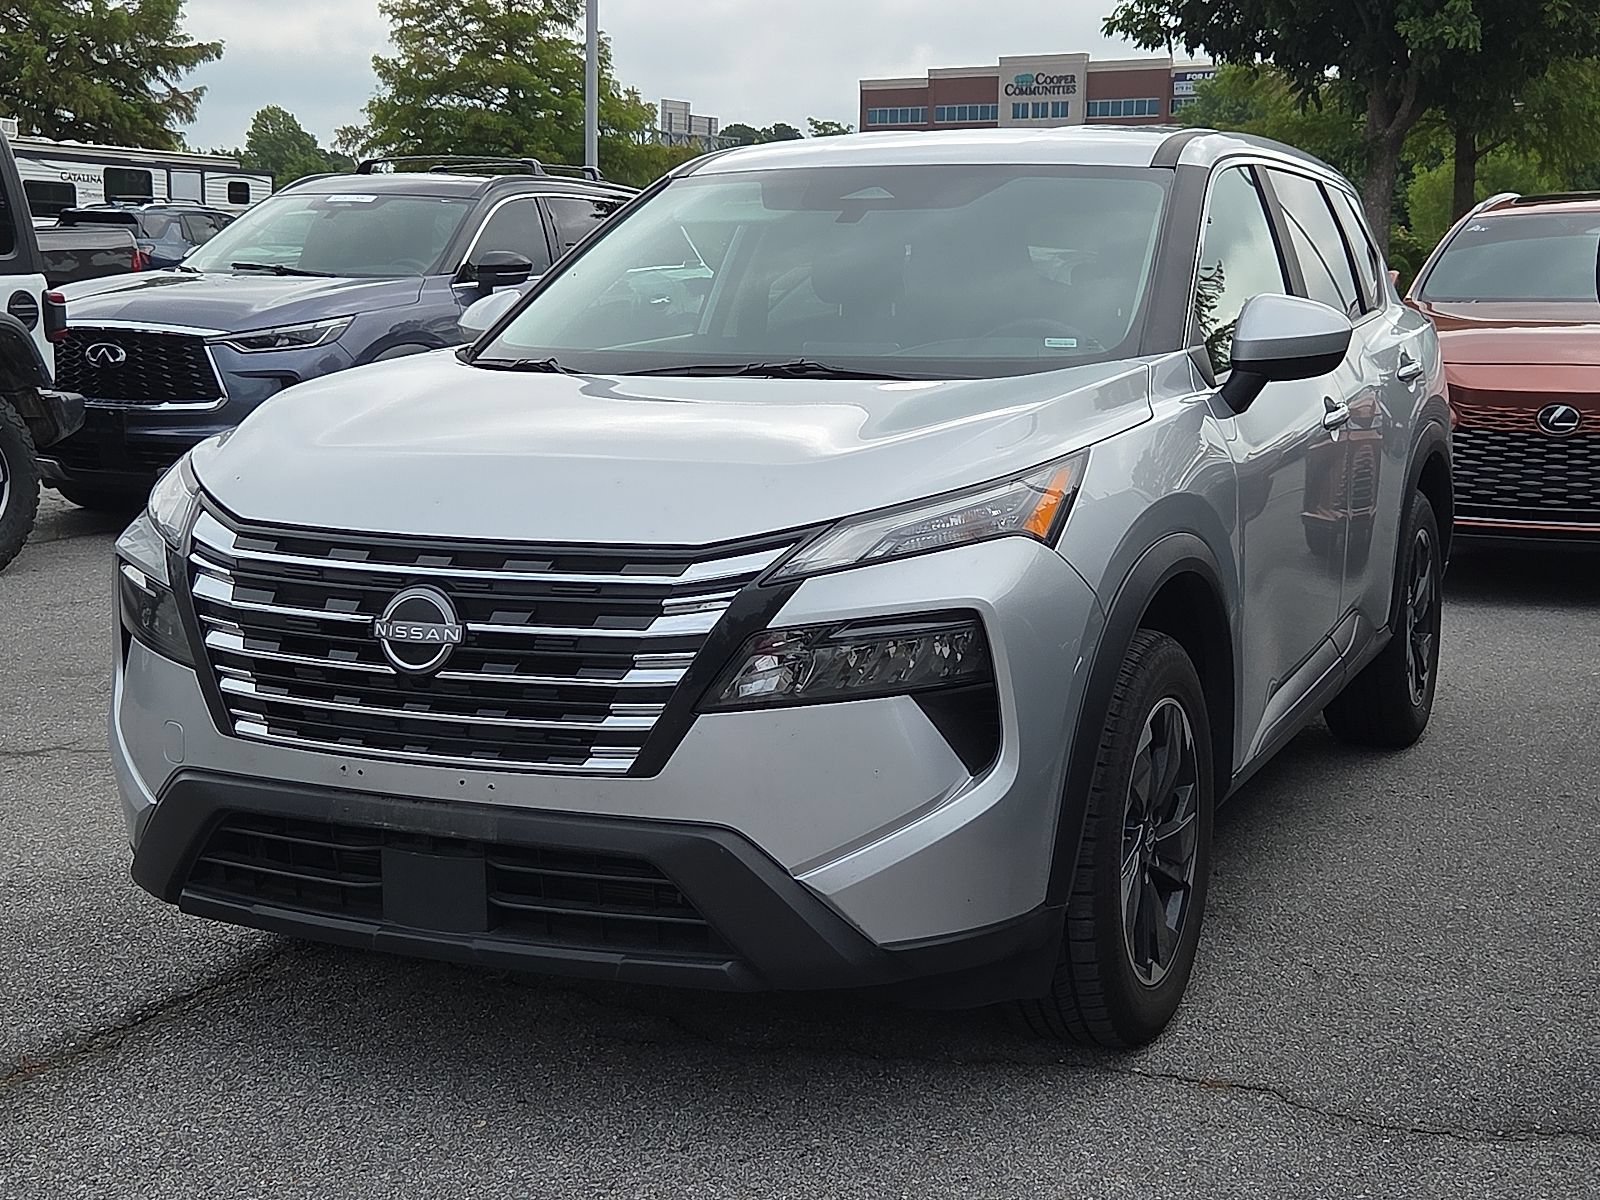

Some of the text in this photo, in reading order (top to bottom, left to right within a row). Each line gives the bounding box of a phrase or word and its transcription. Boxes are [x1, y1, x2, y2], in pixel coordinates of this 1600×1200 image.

[1035, 72, 1077, 85] COOPER
[1186, 73, 1204, 81] FOR
[1004, 83, 1077, 96] COMMUNITIES
[60, 171, 103, 185] CATALINA
[375, 622, 460, 641] NISSAN
